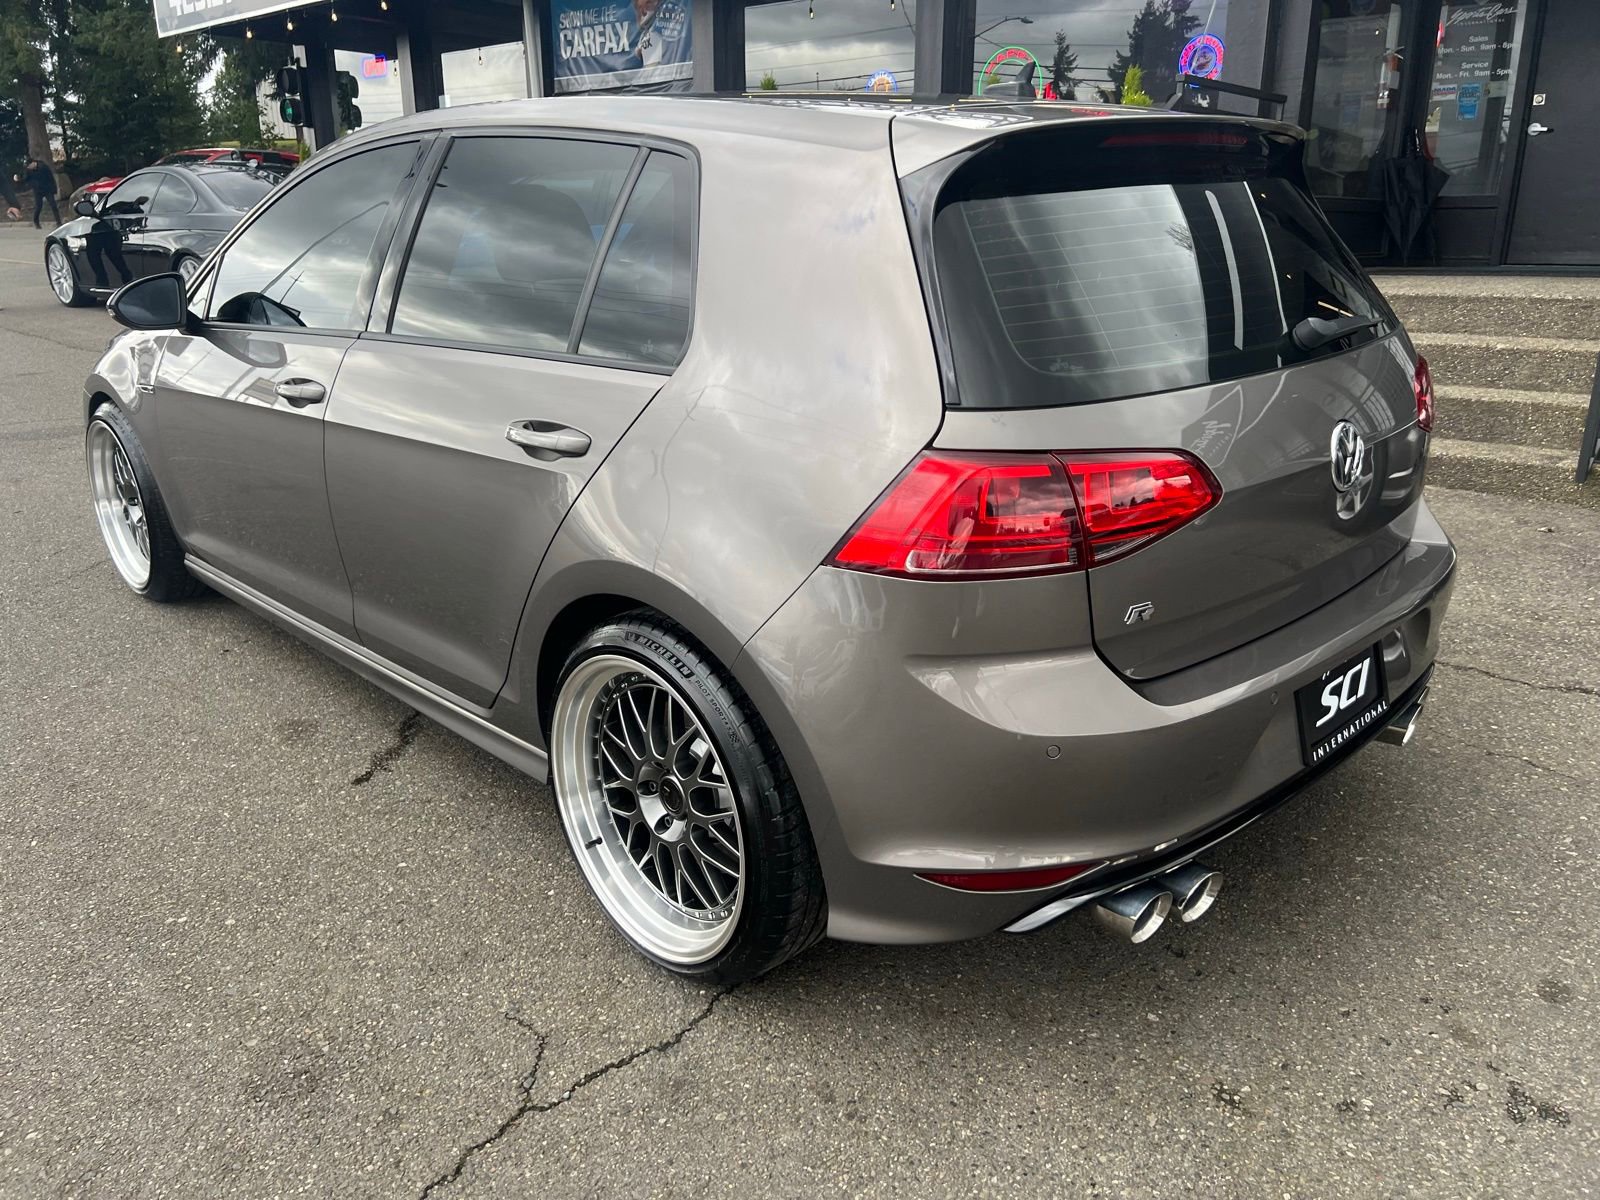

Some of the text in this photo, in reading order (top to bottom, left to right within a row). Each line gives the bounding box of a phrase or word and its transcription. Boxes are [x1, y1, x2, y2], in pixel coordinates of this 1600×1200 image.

[560, 4, 617, 29] SHOW ME THE
[560, 21, 631, 60] CARFAX
[1469, 35, 1489, 43] Sales
[1436, 72, 1453, 80] Mon.
[1496, 68, 1512, 77] 5pm
[637, 635, 691, 678] MICHELIN
[695, 679, 710, 698] PILOT
[709, 698, 727, 721] SPORT
[1315, 657, 1371, 728] SCI
[1312, 700, 1388, 762] INTERNATIONAL
